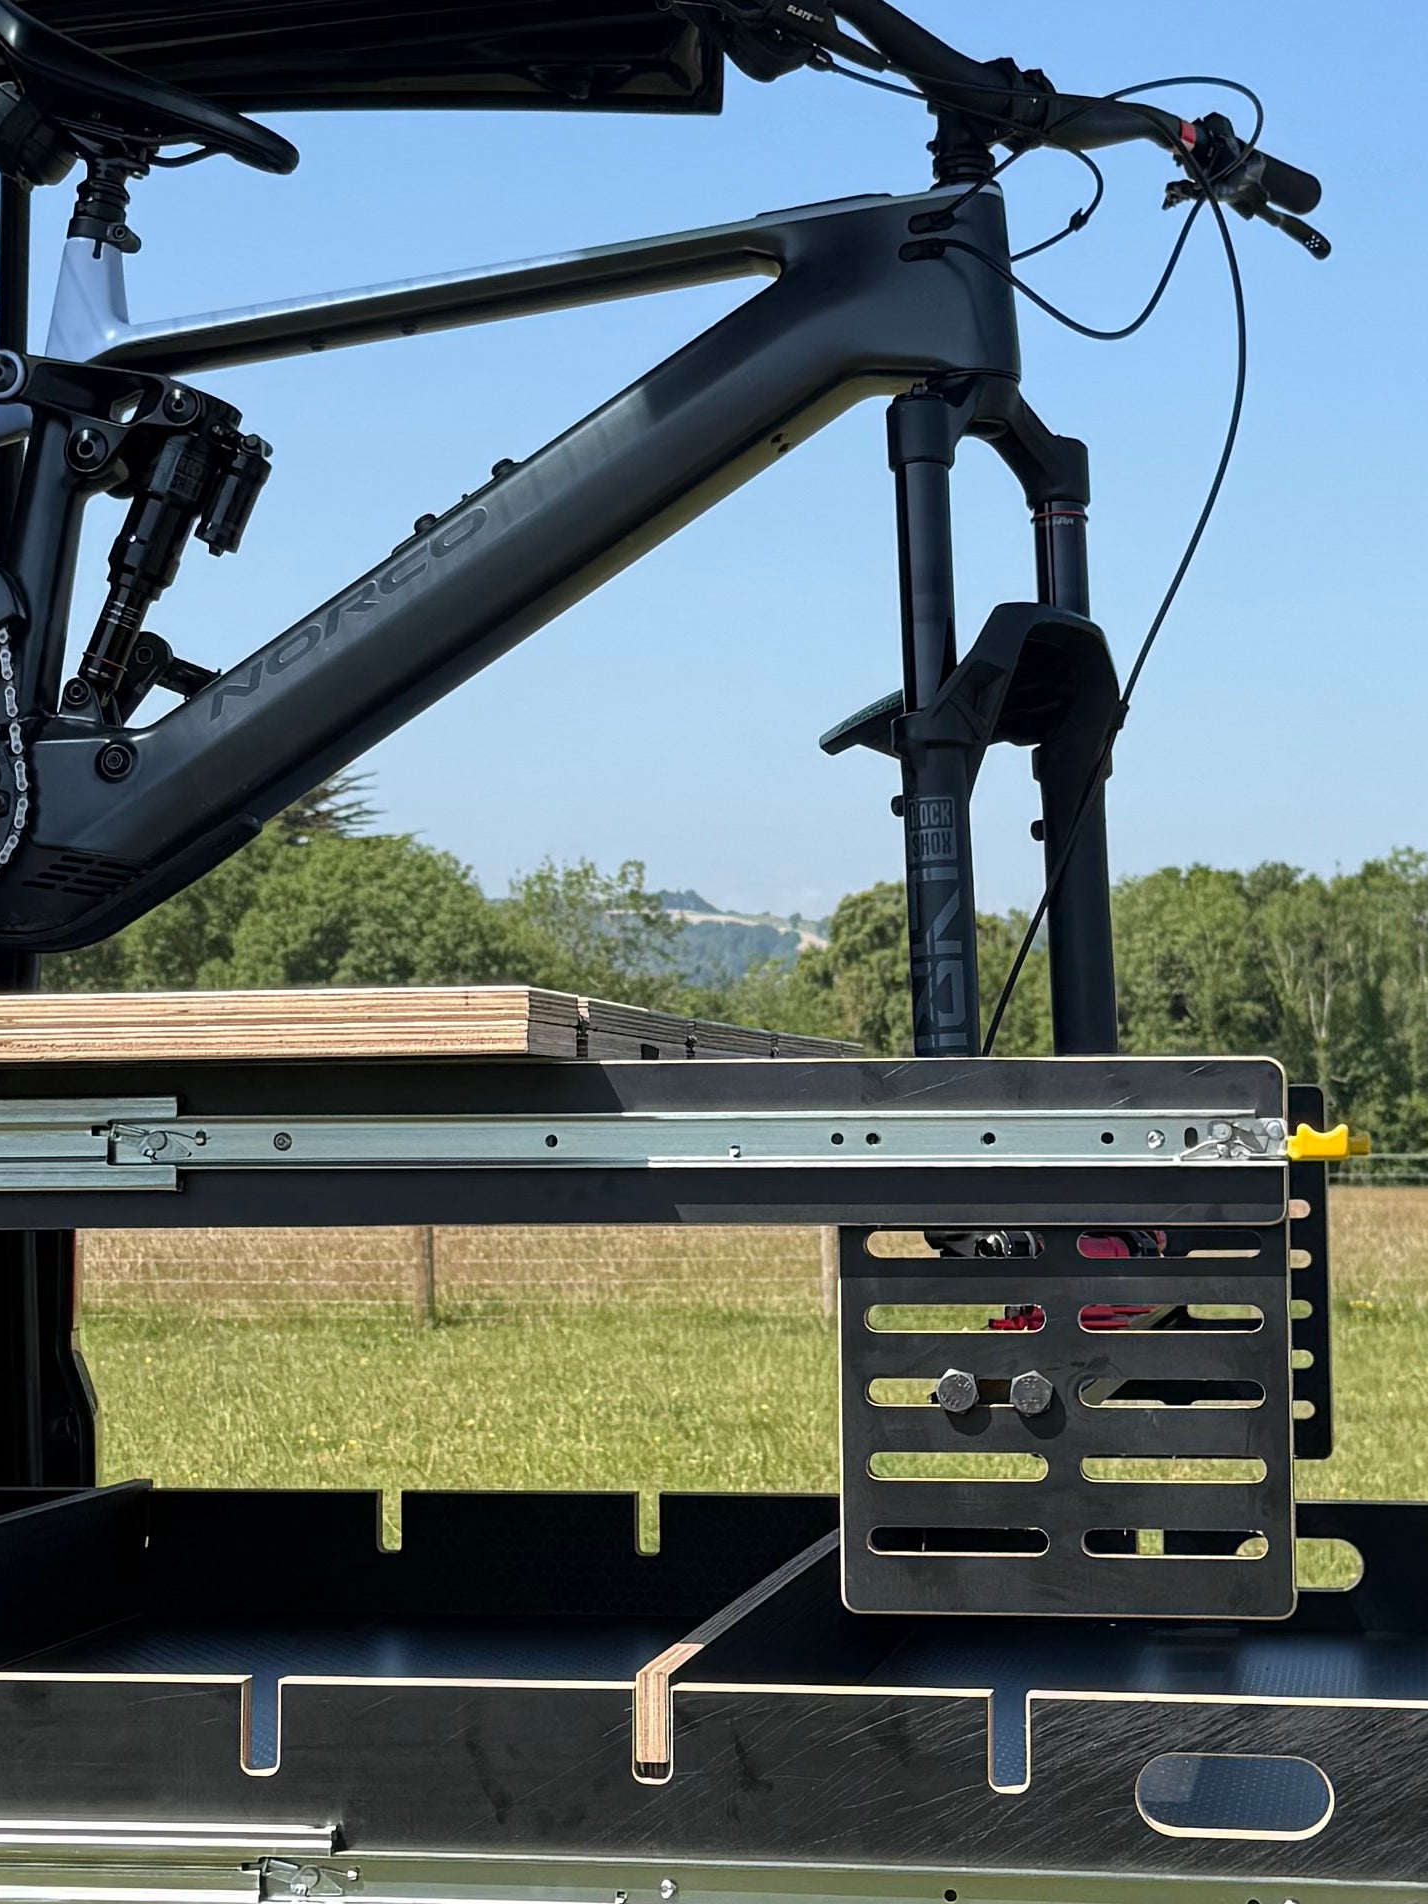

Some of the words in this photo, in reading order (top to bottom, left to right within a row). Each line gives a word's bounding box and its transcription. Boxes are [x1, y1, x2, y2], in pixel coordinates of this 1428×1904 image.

[209, 505, 488, 723] NORCO
[912, 831, 952, 857] SHOX
[910, 866, 968, 1056] LYRI
